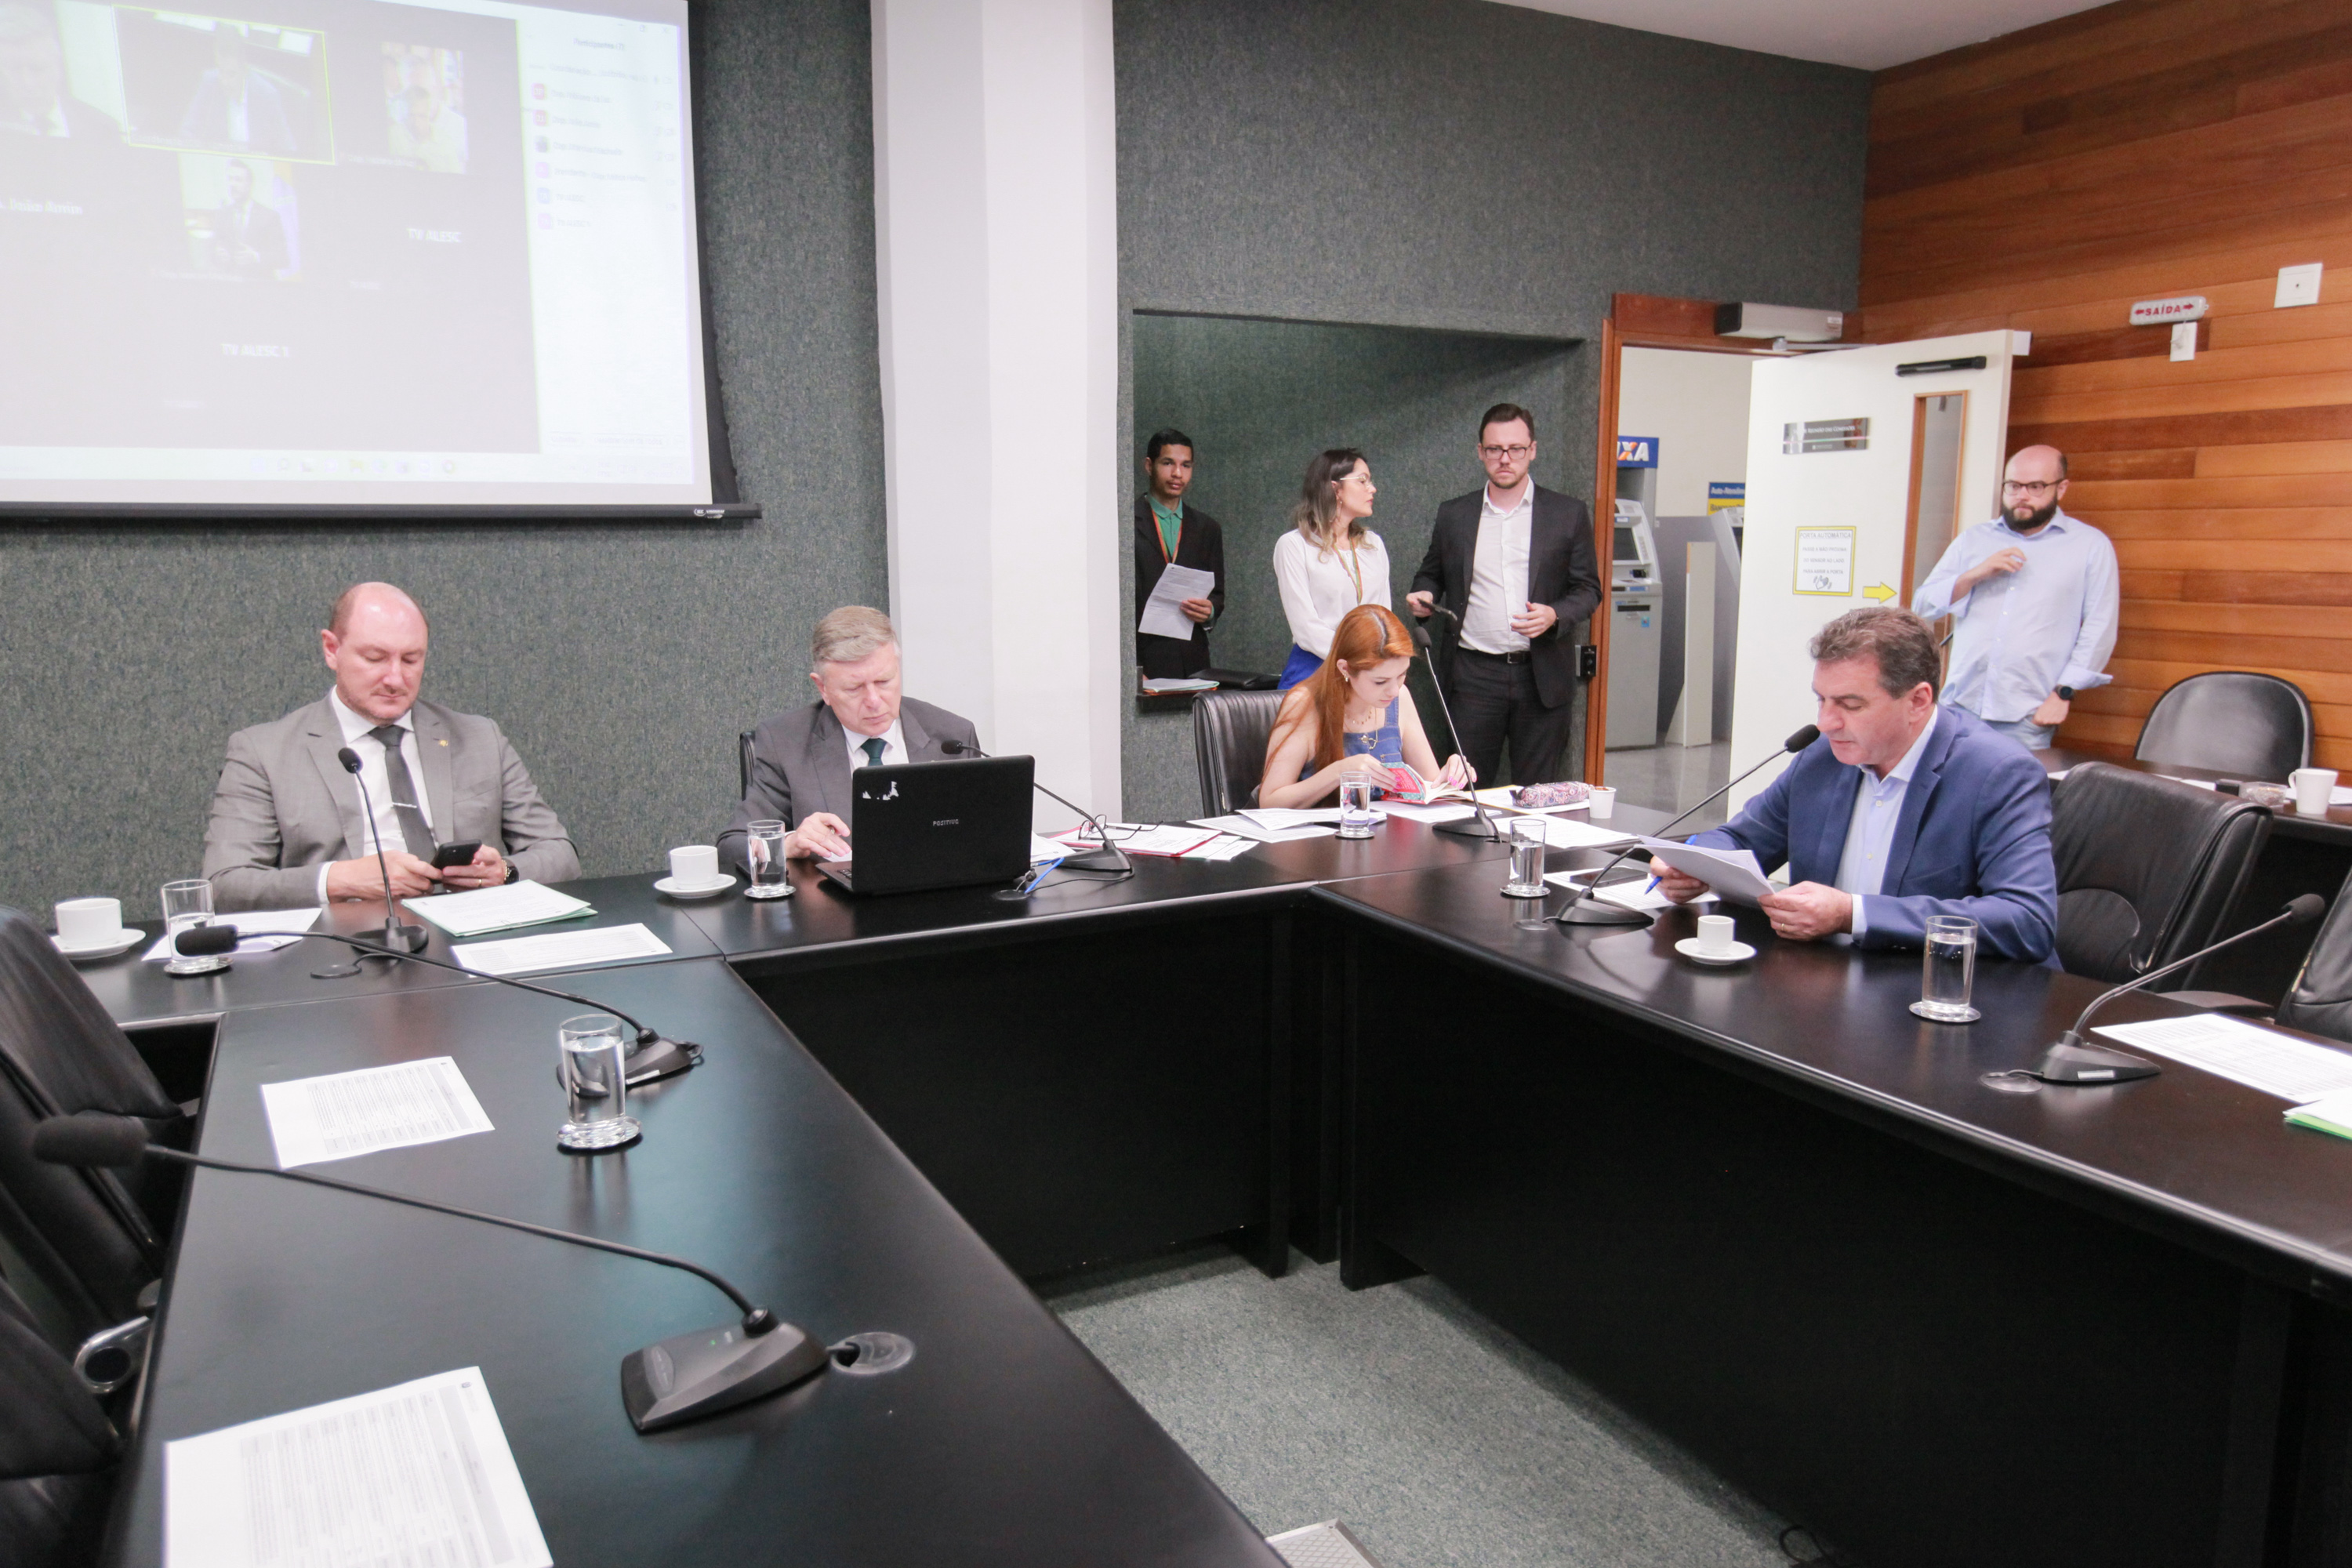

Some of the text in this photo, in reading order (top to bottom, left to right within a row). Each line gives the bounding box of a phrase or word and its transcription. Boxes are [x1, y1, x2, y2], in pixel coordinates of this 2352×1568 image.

[407, 227, 463, 243] TV ALESC
[2145, 304, 2181, 316] SAÍDA
[221, 343, 238, 356] TV
[240, 343, 281, 358] ALESC
